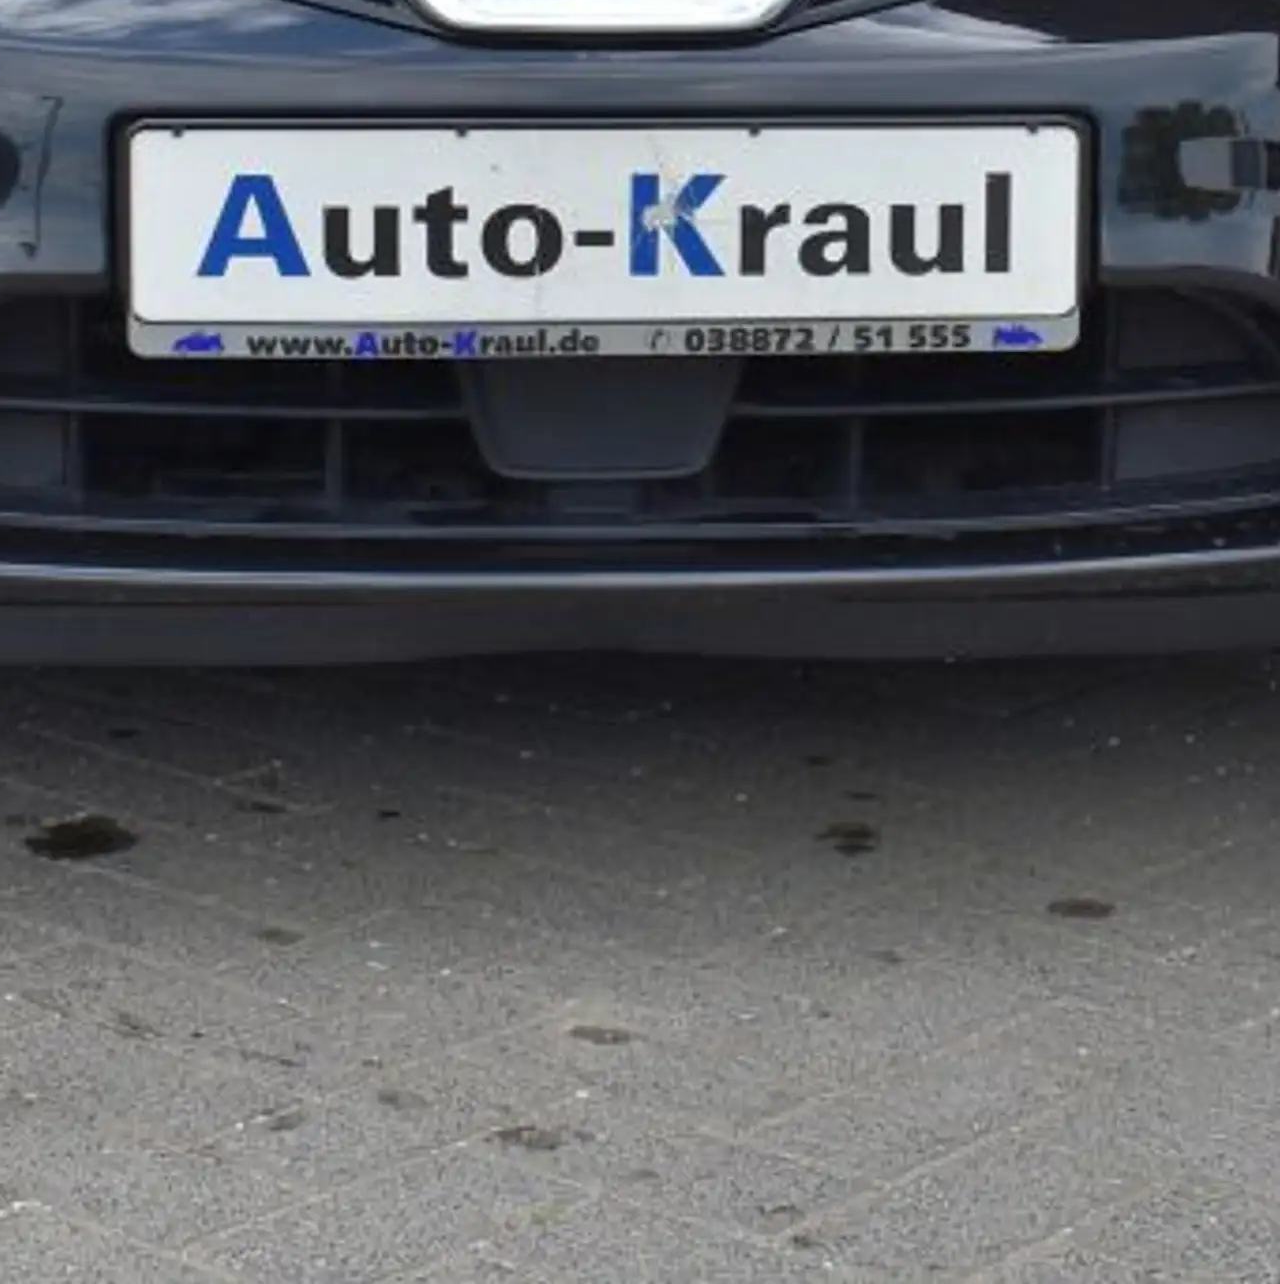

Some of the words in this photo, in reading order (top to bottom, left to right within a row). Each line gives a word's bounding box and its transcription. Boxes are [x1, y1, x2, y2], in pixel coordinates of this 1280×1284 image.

[197, 171, 1012, 279] Auto-Kraul
[246, 329, 600, 357] www.Auto-Kraul.de
[684, 325, 815, 353] 038872
[853, 324, 893, 351] 51
[908, 323, 972, 349] 555
